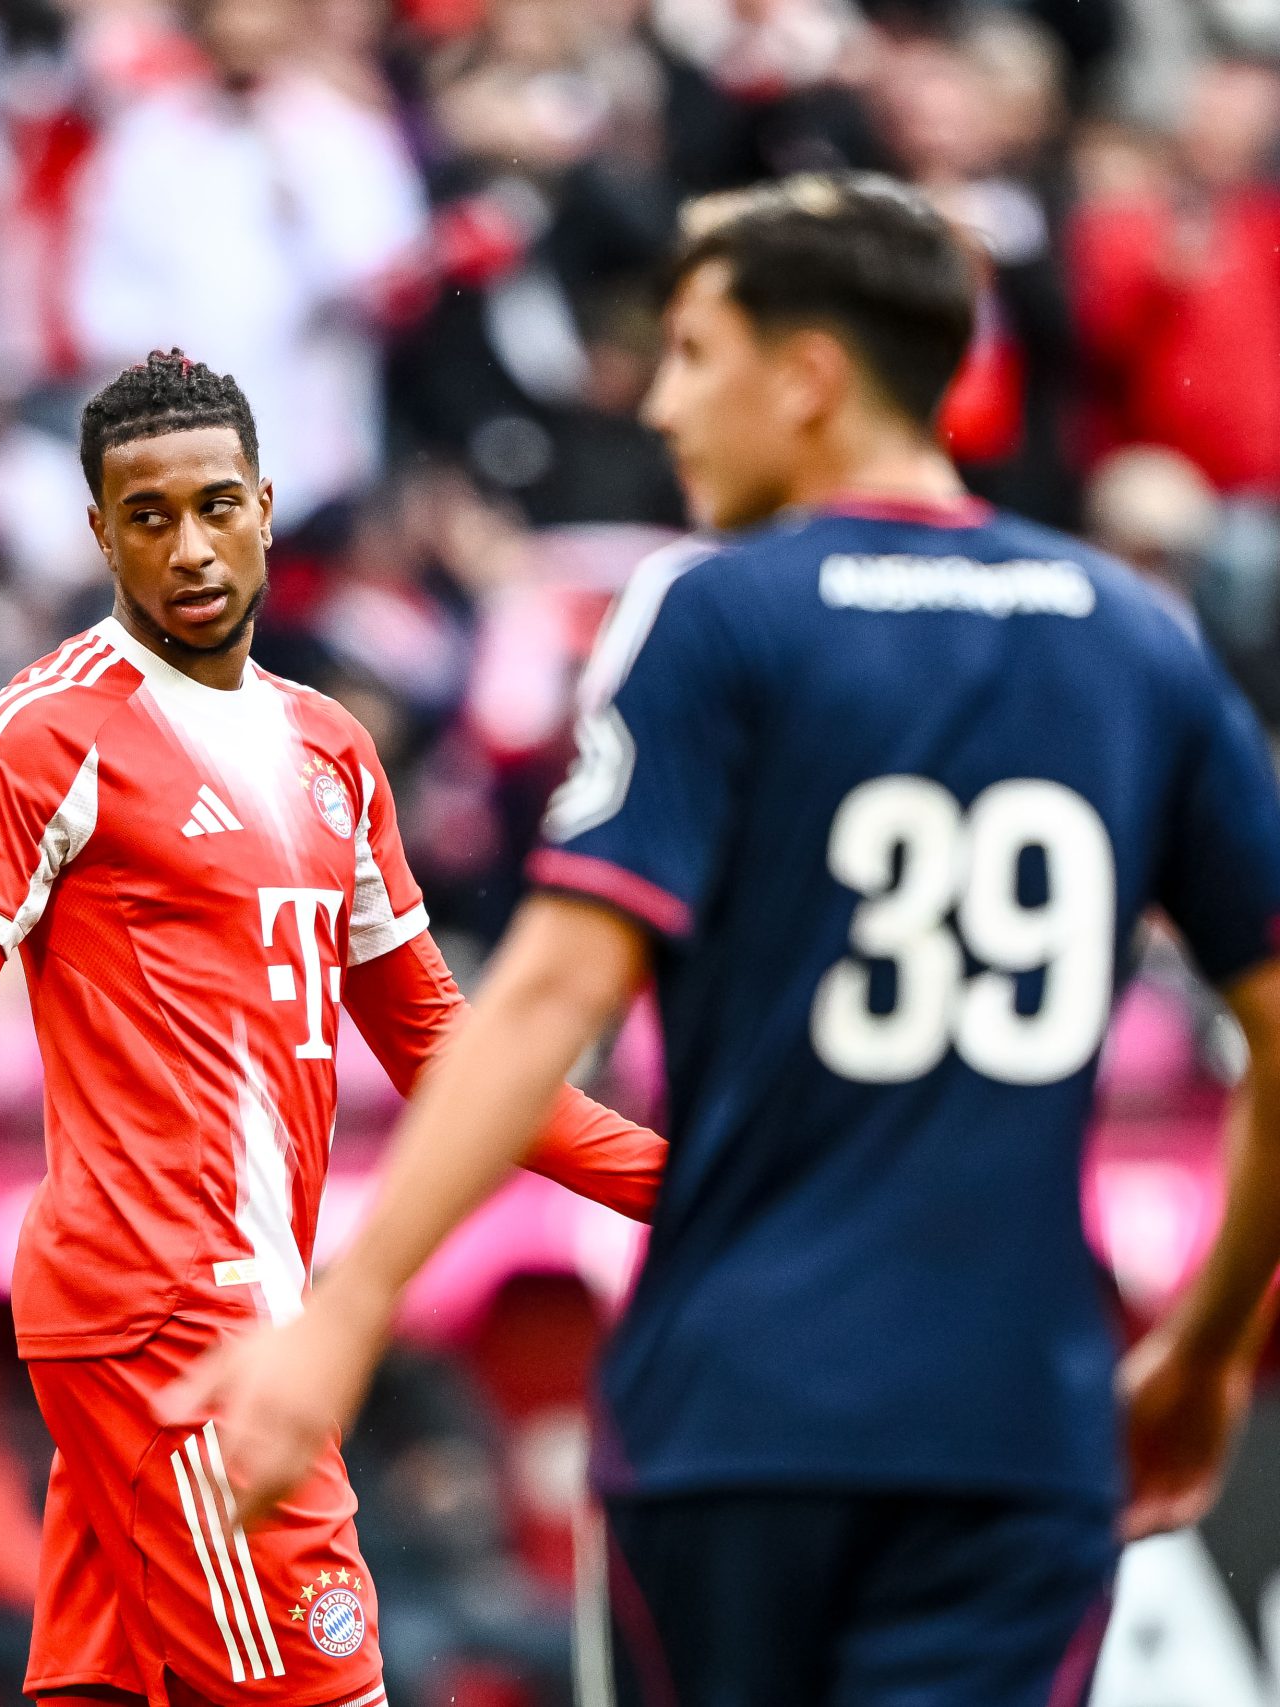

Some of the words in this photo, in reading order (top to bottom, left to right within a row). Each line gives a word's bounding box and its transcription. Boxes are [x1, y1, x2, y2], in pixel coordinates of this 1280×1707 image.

[258, 887, 344, 1059] T
[811, 774, 1118, 1085] 39
[314, 1612, 324, 1627] FC
[320, 1593, 358, 1611] BAYERN
